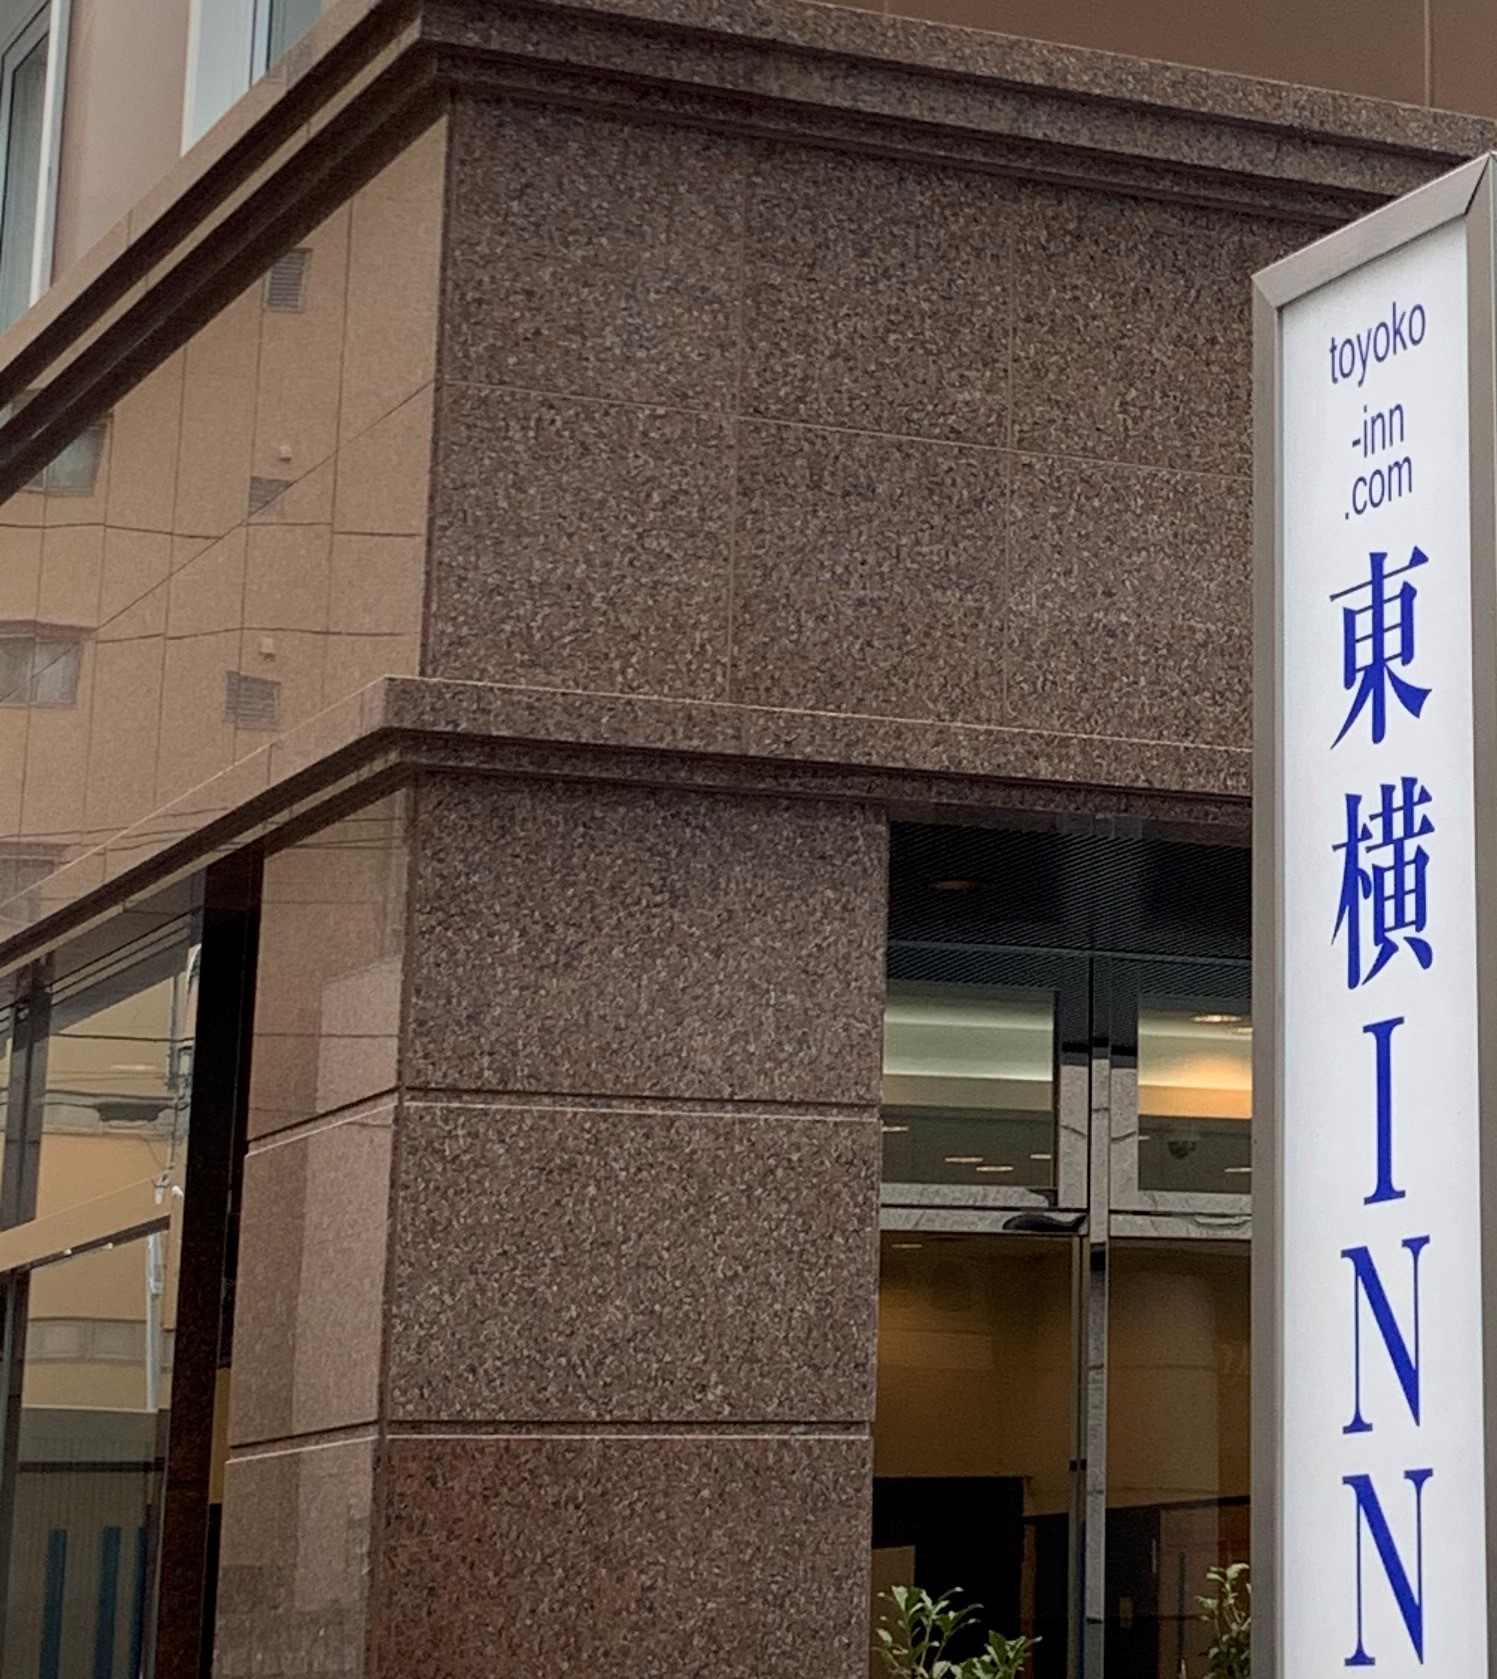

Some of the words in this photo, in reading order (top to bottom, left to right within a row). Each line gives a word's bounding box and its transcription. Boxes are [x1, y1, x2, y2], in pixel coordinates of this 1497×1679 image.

[1330, 301, 1427, 387] toyoko
[1351, 402, 1405, 461] -inn
[1344, 452, 1413, 520] .com
